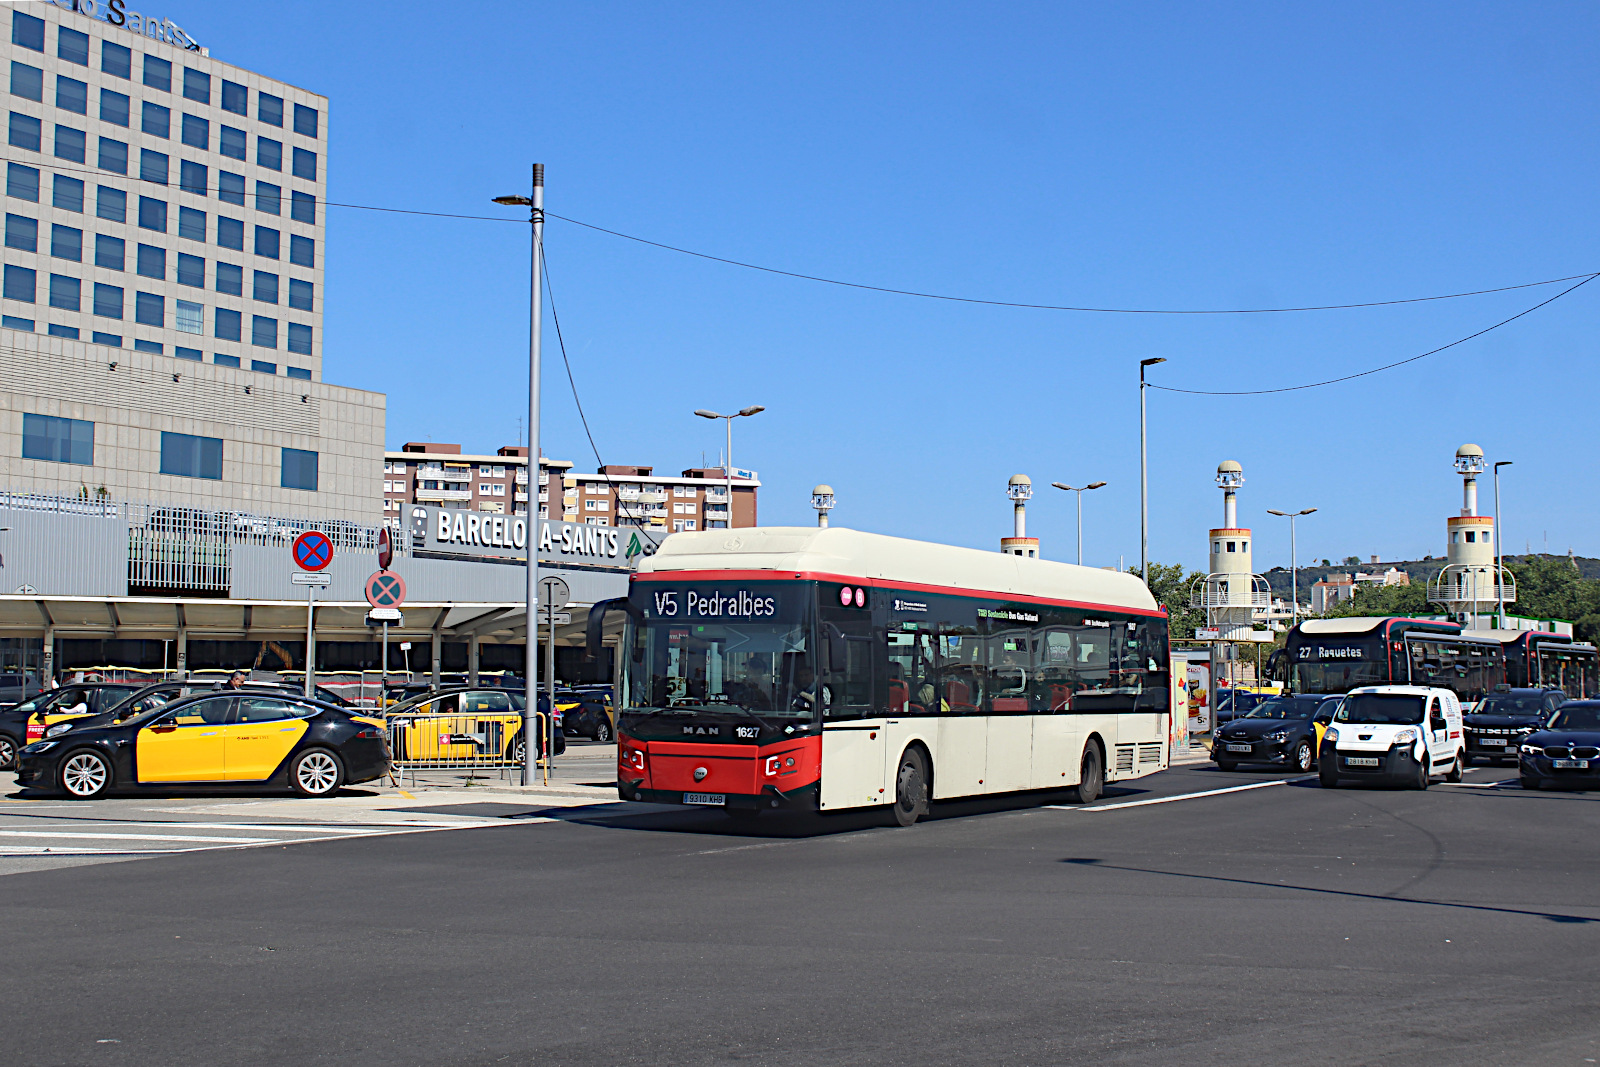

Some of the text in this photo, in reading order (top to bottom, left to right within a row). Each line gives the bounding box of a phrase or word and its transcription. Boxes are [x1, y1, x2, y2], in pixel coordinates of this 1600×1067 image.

[106, 0, 188, 49] Sants
[436, 510, 619, 557] BARCELOA-SANTS
[655, 590, 775, 616] V5 Pedralbes
[857, 591, 864, 603] B
[1299, 646, 1362, 659] 27 Roquetes
[683, 725, 719, 736] MAN
[735, 726, 760, 738] 1627
[688, 794, 707, 803] 9310
